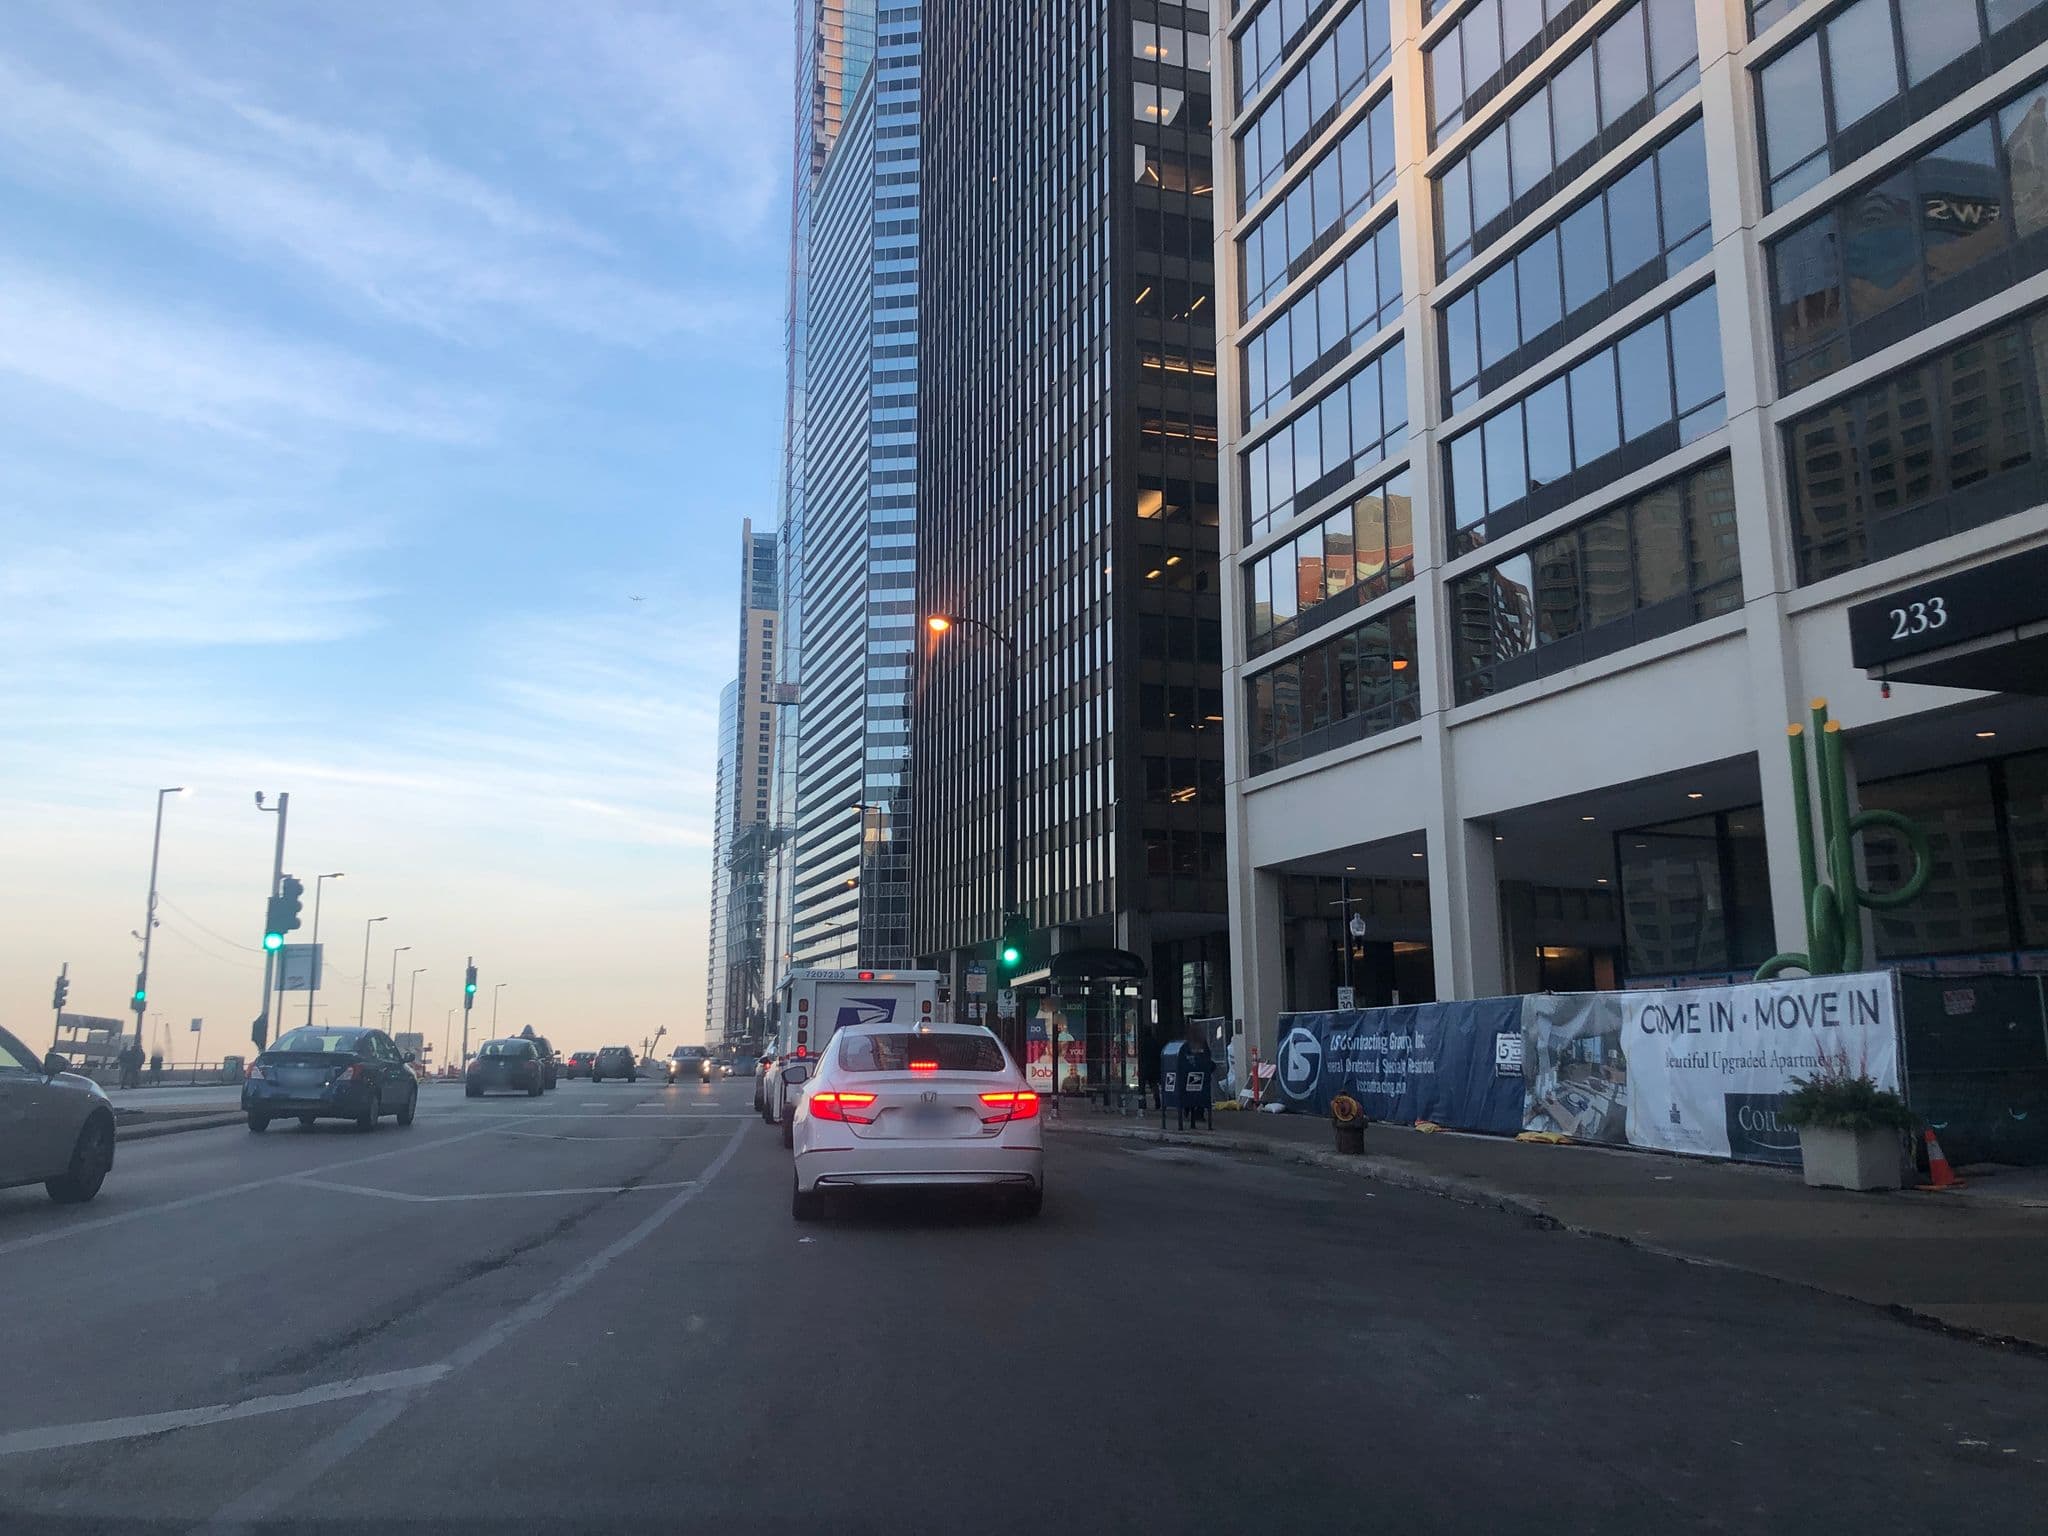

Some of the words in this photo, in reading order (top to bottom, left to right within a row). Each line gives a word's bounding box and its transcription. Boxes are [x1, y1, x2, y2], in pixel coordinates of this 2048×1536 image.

[1889, 597, 1947, 640] 233
[1640, 1003, 1701, 1034] COME
[1709, 1001, 1734, 1032] IN
[1755, 993, 1840, 1030] MOVE
[1847, 989, 1881, 1026] IN
[1665, 1050, 1709, 1069] eautiful
[1710, 1050, 1767, 1075] Upgraded
